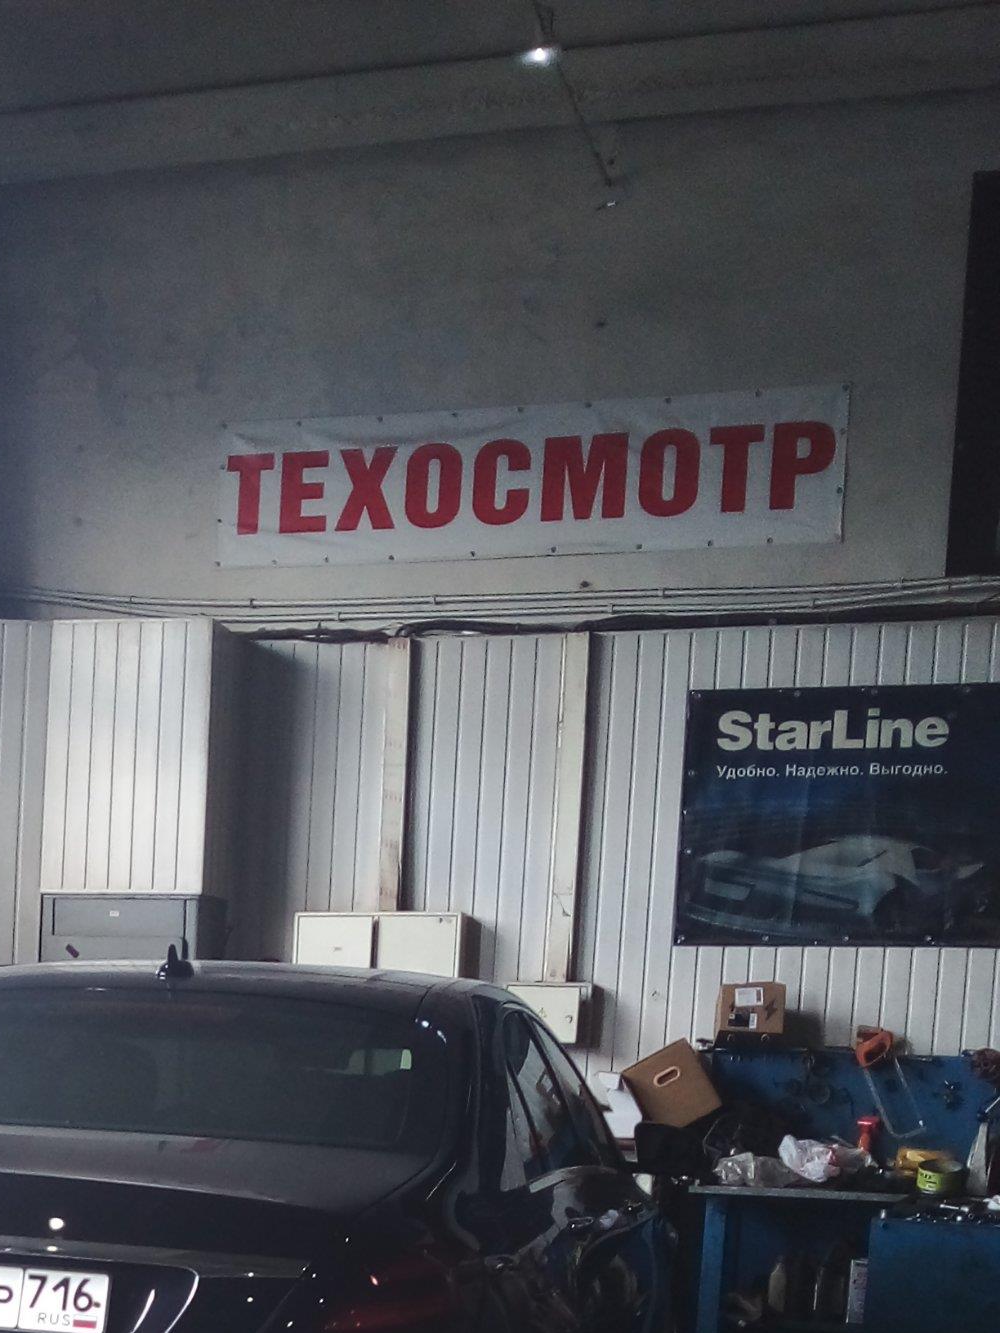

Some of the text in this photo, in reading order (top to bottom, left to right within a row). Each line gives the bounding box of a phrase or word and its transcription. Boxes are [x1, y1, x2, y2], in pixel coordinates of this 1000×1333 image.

[227, 420, 836, 536] ТЕХОСМОТР
[717, 708, 949, 751] StarLine
[717, 763, 948, 779] Удобно. Надежно. Выгодно.
[28, 1274, 94, 1312] 716
[37, 1312, 71, 1327] RUS
